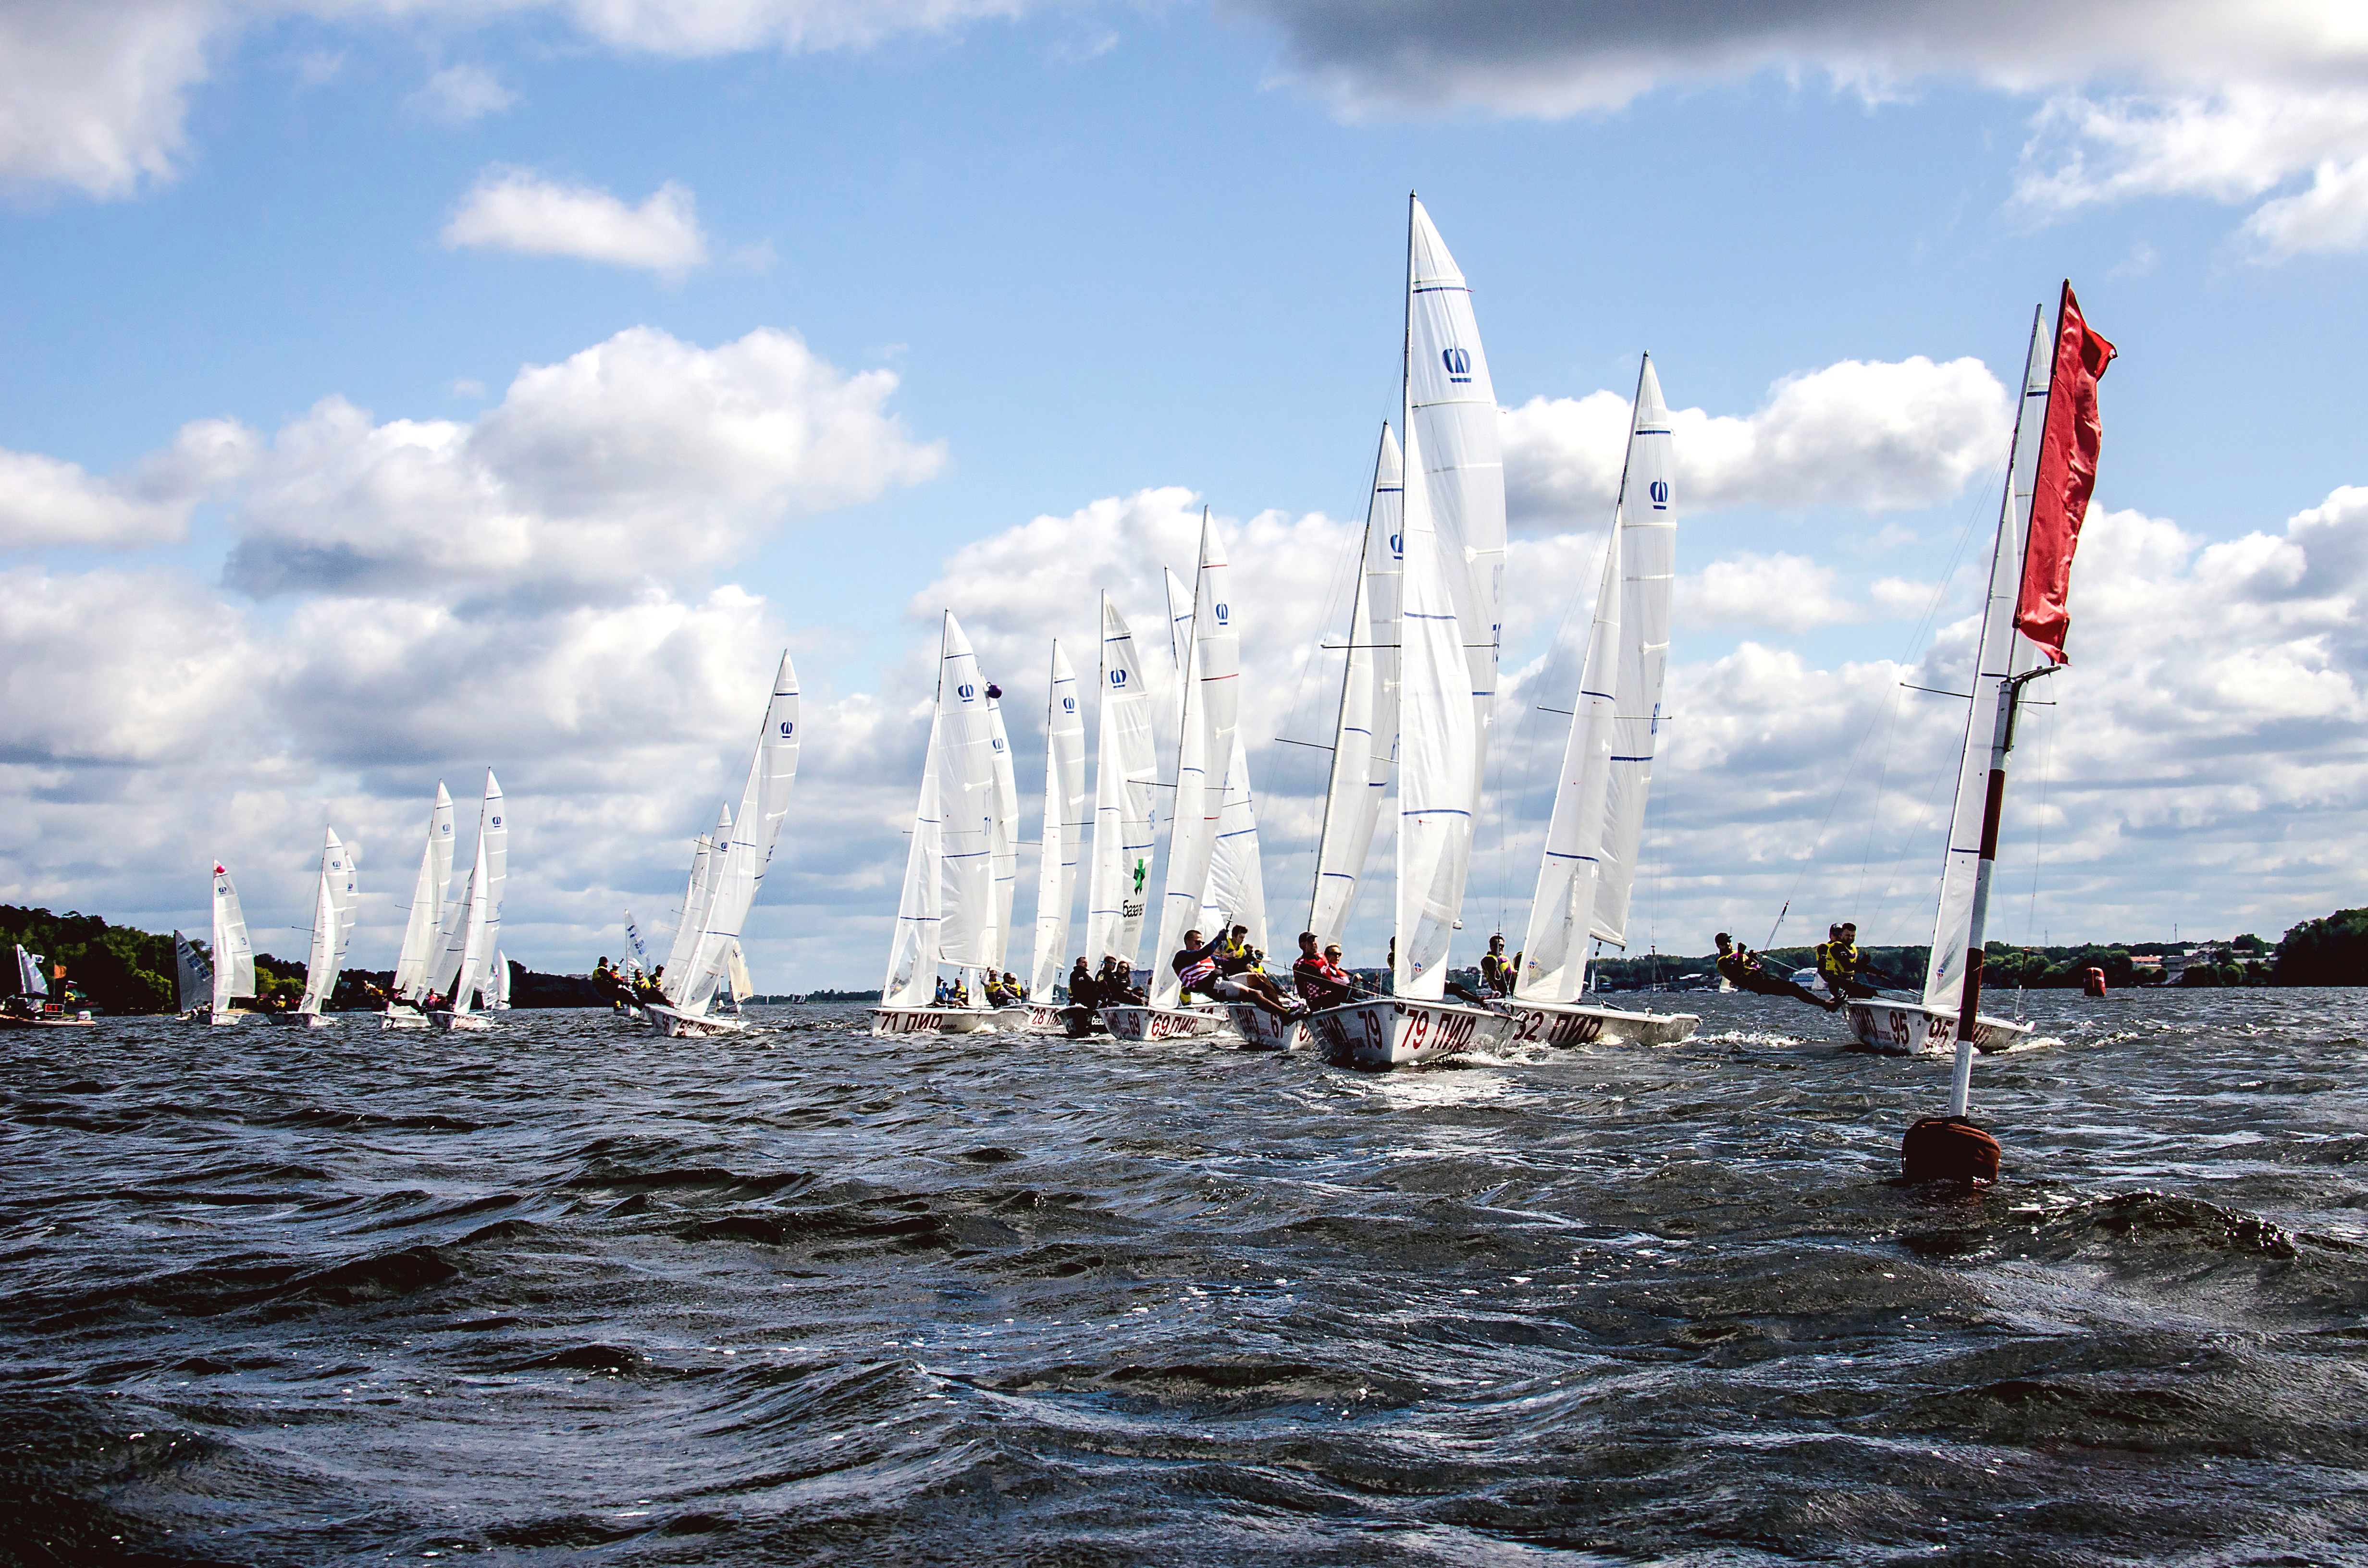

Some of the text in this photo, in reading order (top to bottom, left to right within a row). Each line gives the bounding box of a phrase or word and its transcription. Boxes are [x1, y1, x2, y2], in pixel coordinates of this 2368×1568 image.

[881, 1013, 899, 1030] 71
[1032, 1008, 1046, 1025] 28
[1127, 1012, 1141, 1037] 69
[1151, 1014, 1171, 1037] 69
[1889, 1011, 1910, 1045] 95
[1357, 1009, 1382, 1050] 79
[1401, 1009, 1430, 1050] 79
